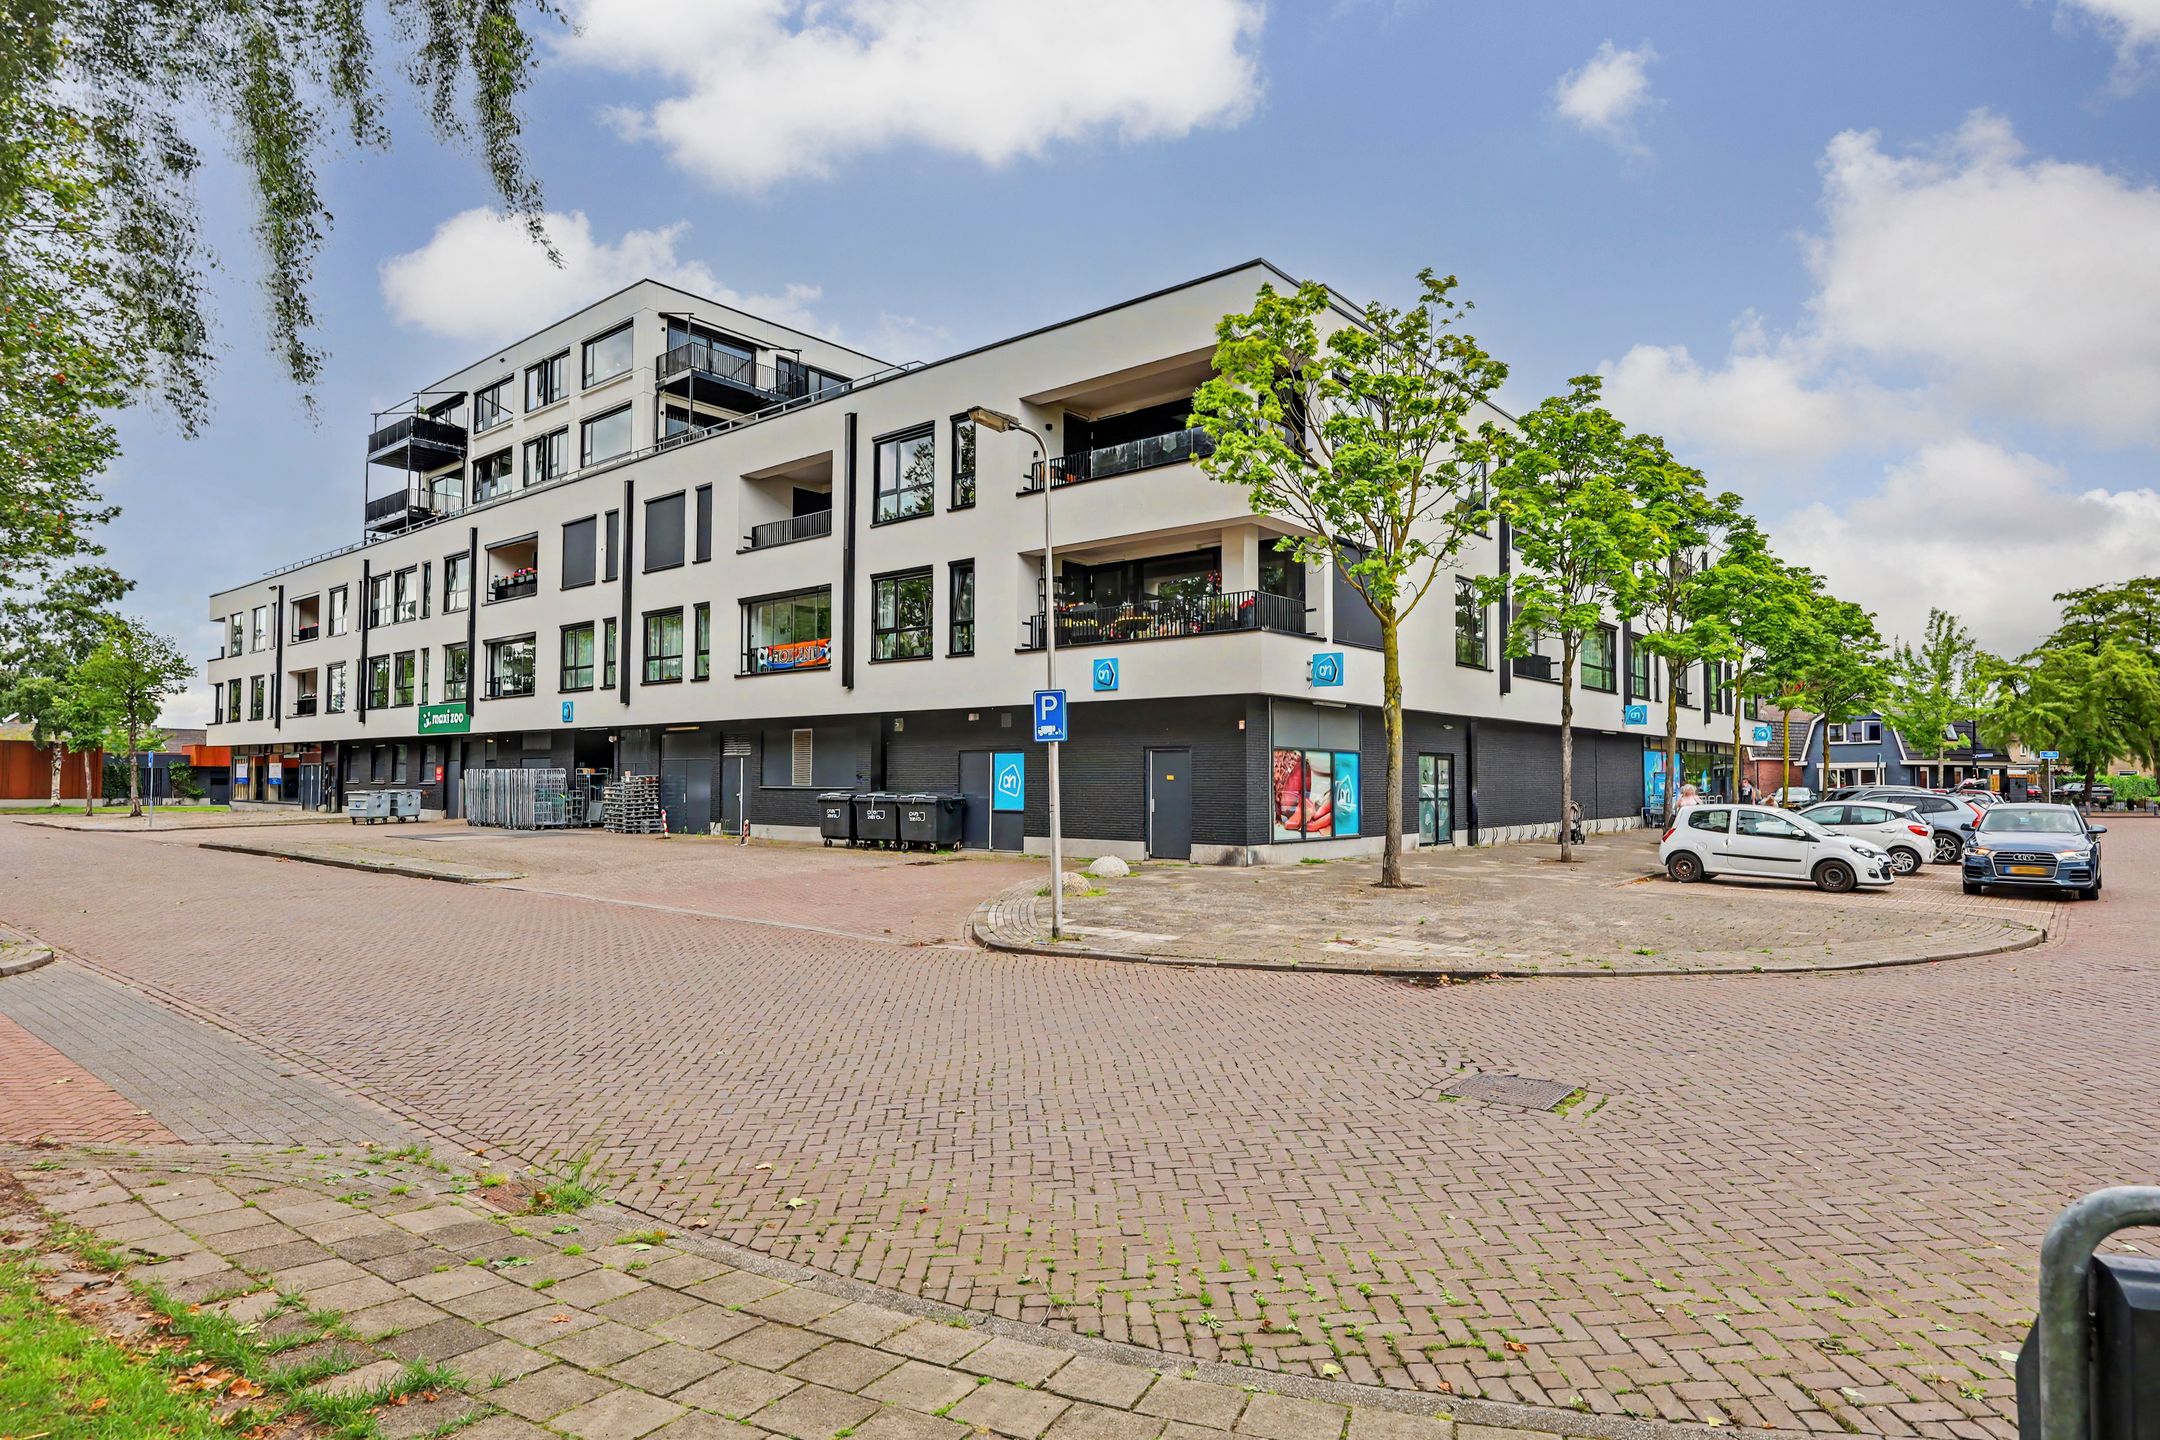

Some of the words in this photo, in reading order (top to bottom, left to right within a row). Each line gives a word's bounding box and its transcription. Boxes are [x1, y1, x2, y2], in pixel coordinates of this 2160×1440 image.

[432, 709, 450, 725] maxi
[450, 712, 464, 724] zoo
[1041, 695, 1058, 721] P
